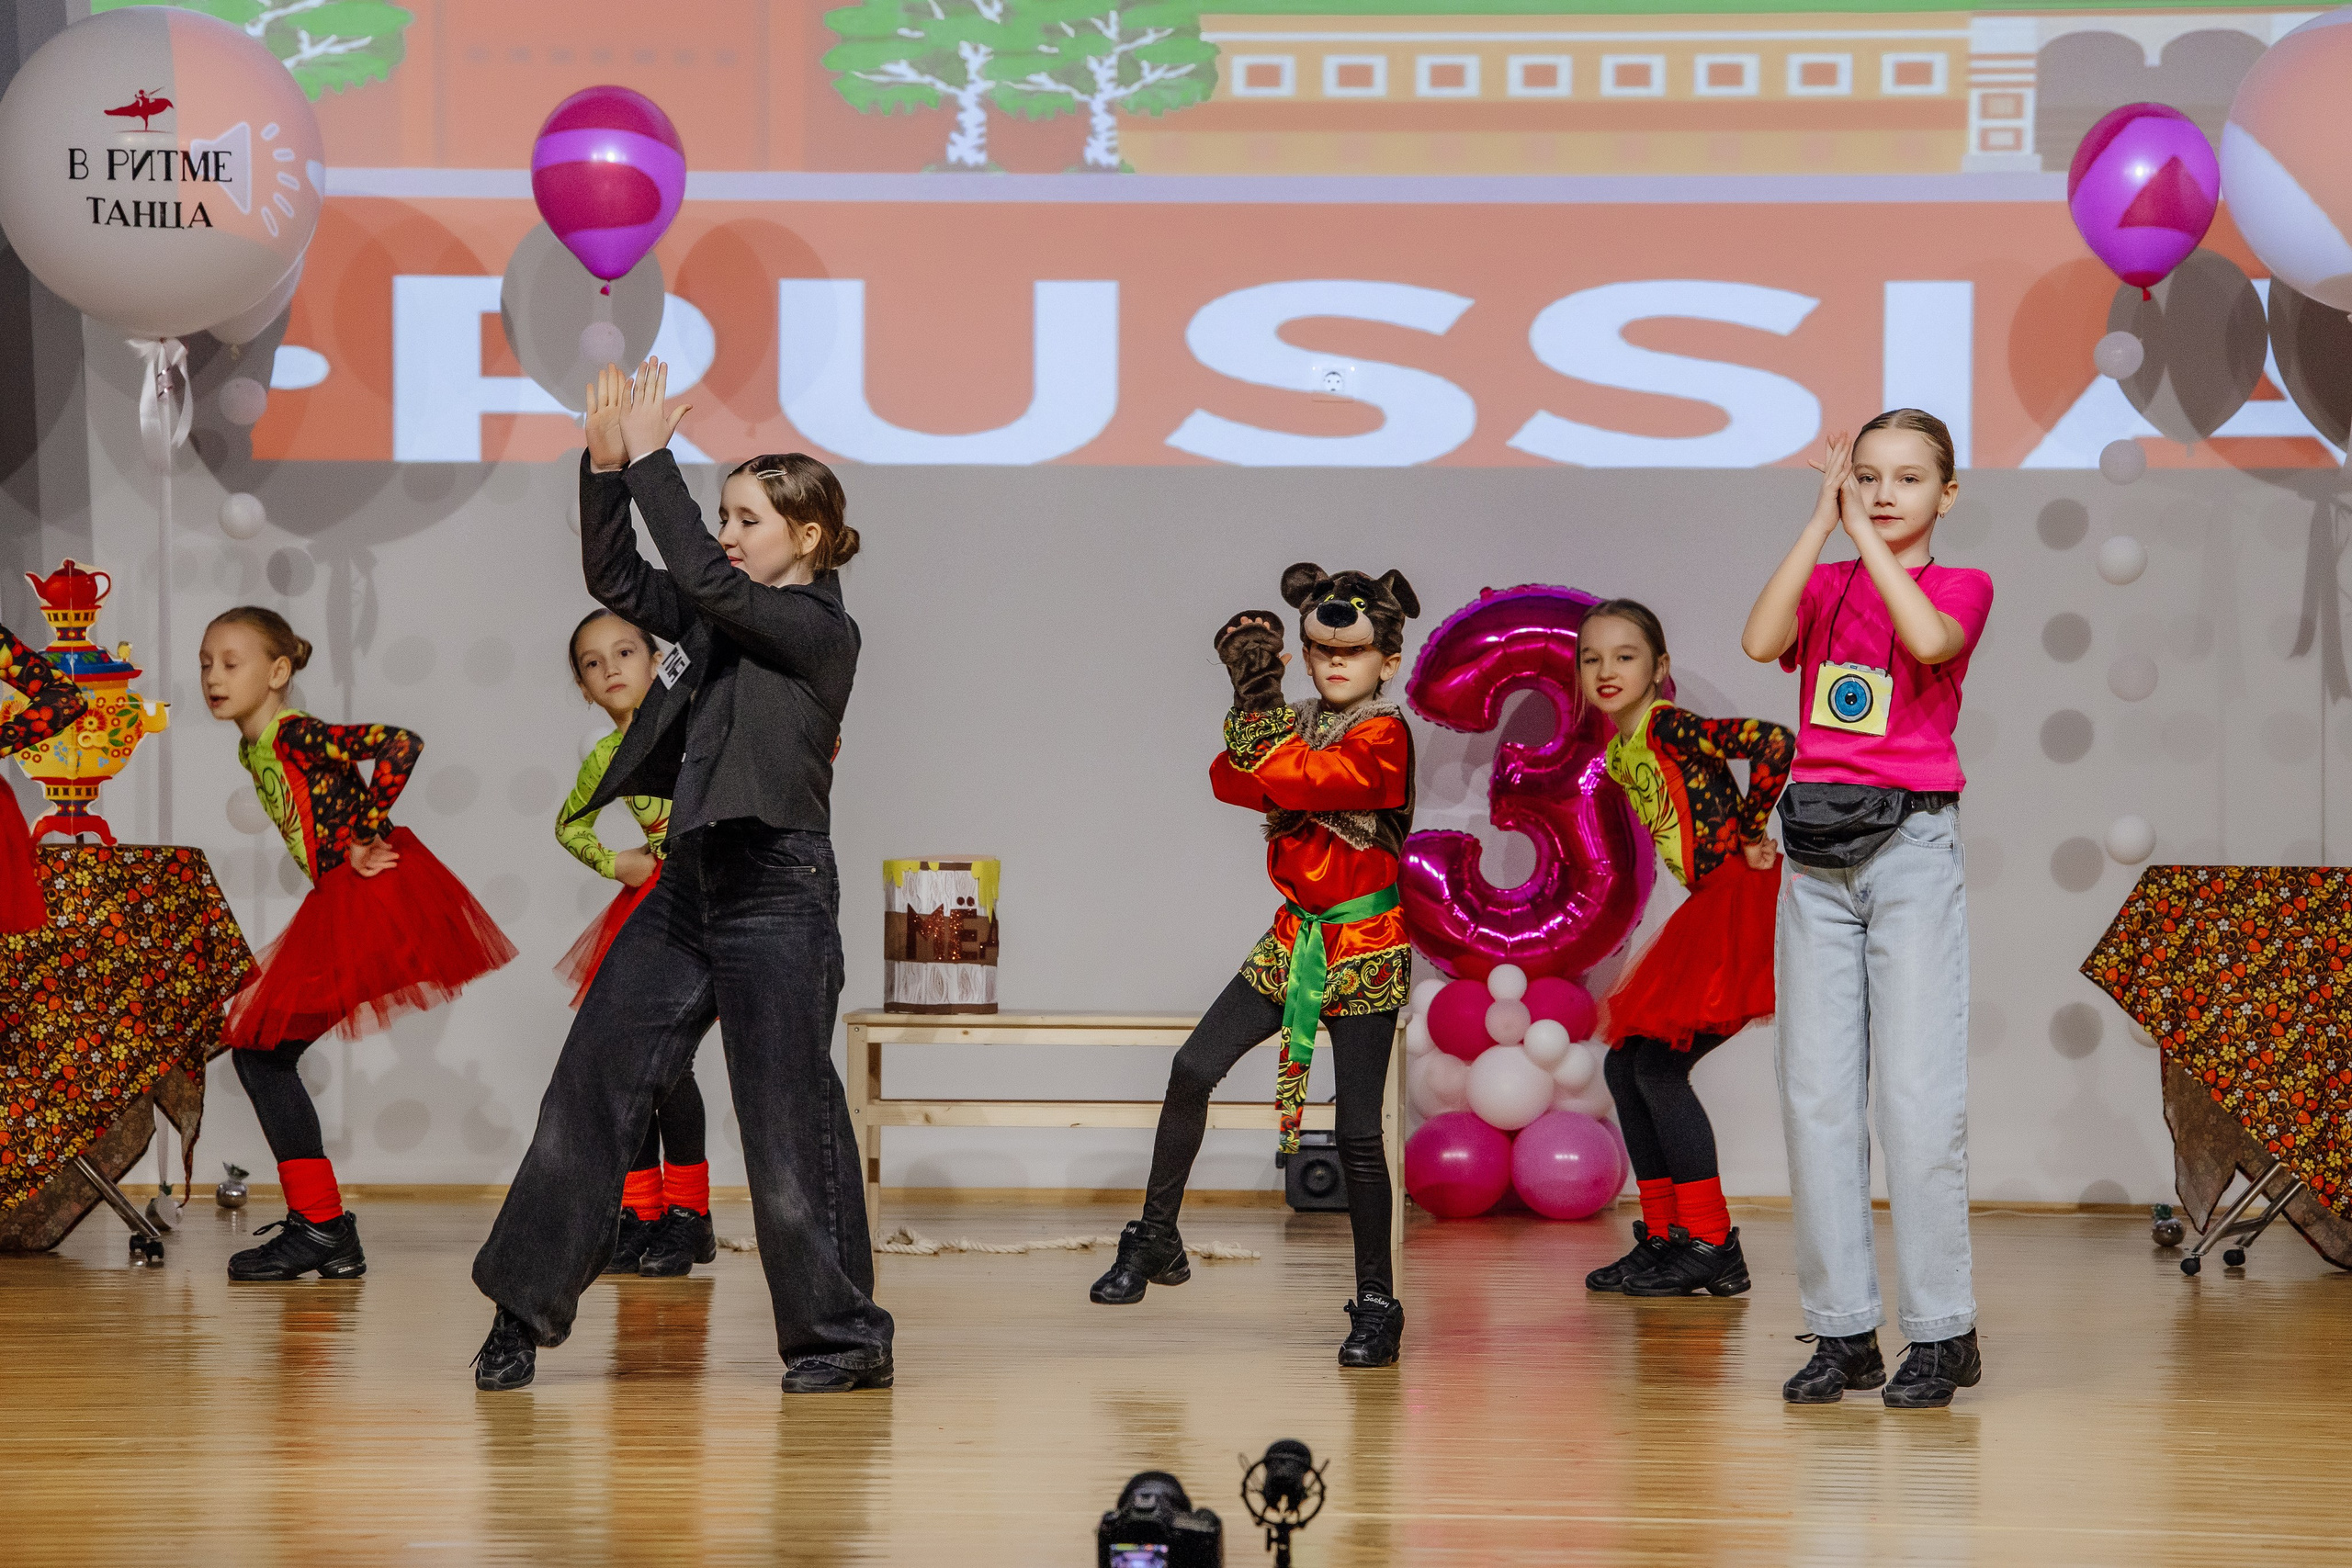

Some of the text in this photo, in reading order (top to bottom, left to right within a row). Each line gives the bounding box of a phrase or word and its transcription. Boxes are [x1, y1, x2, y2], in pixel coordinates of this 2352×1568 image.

[69, 148, 233, 182] В РИТМЕ
[85, 196, 214, 230] ТАНЦА
[1398, 583, 1676, 981] 3
[905, 896, 1000, 962] МЁД
